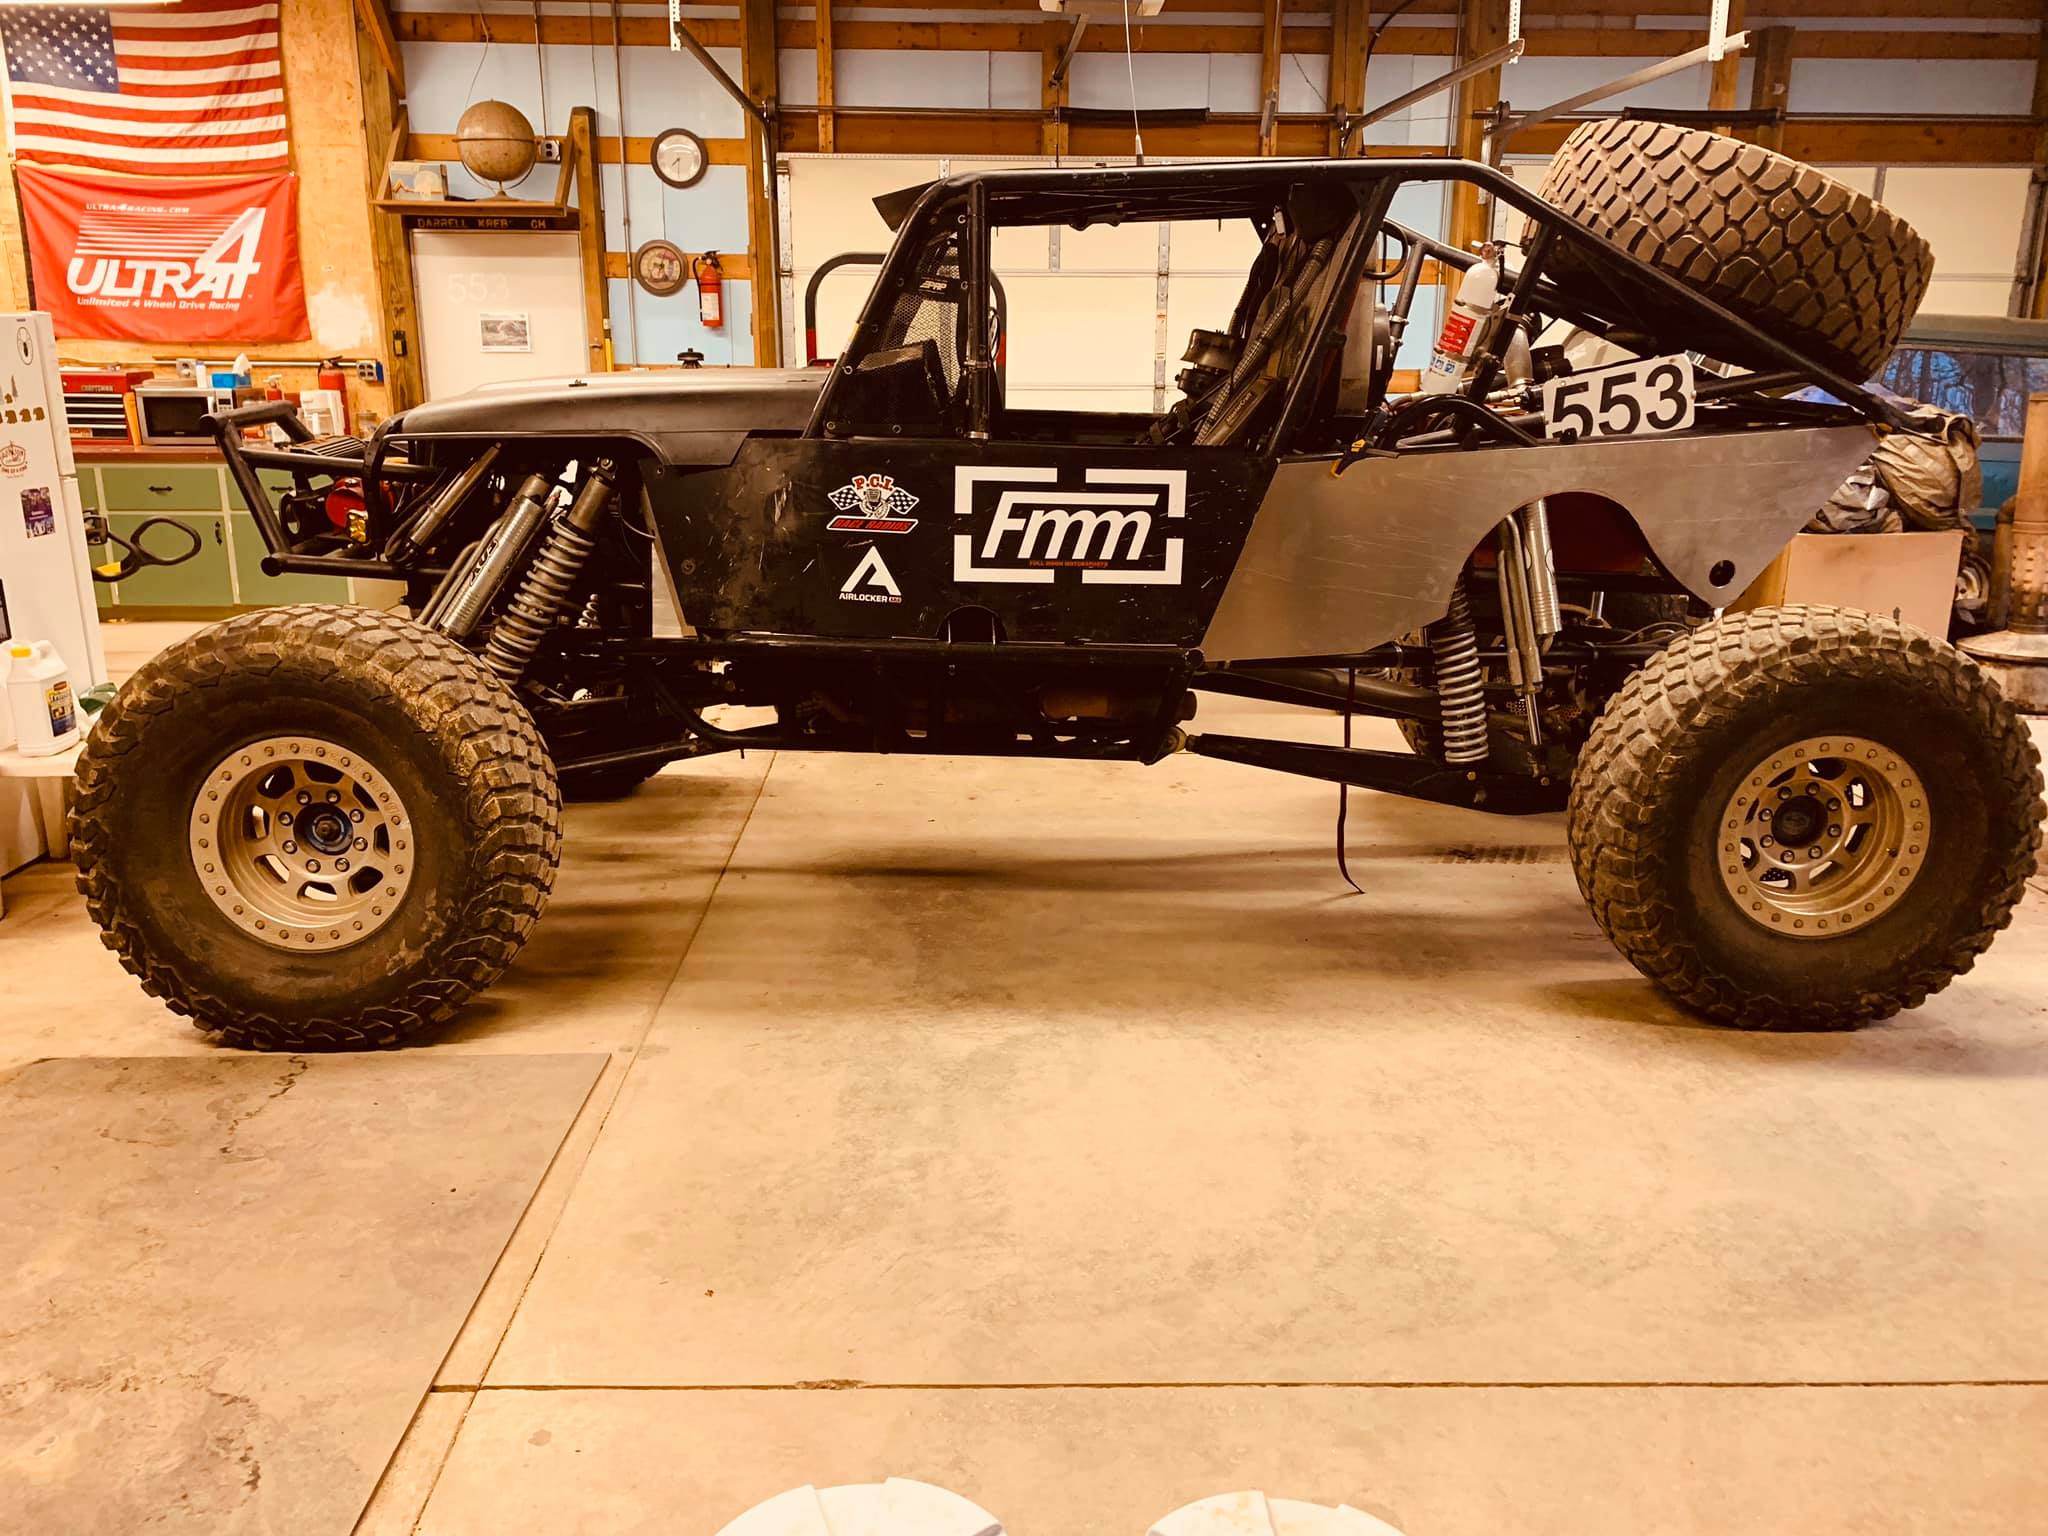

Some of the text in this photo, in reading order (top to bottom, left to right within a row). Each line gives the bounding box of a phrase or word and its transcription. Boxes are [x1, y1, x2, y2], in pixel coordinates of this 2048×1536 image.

[77, 296, 241, 312] Unlimited 4 Wheel Drive Racing
[1552, 363, 1688, 440] 553
[831, 518, 865, 530] RACE
[838, 592, 888, 604] AIRLOCKER
